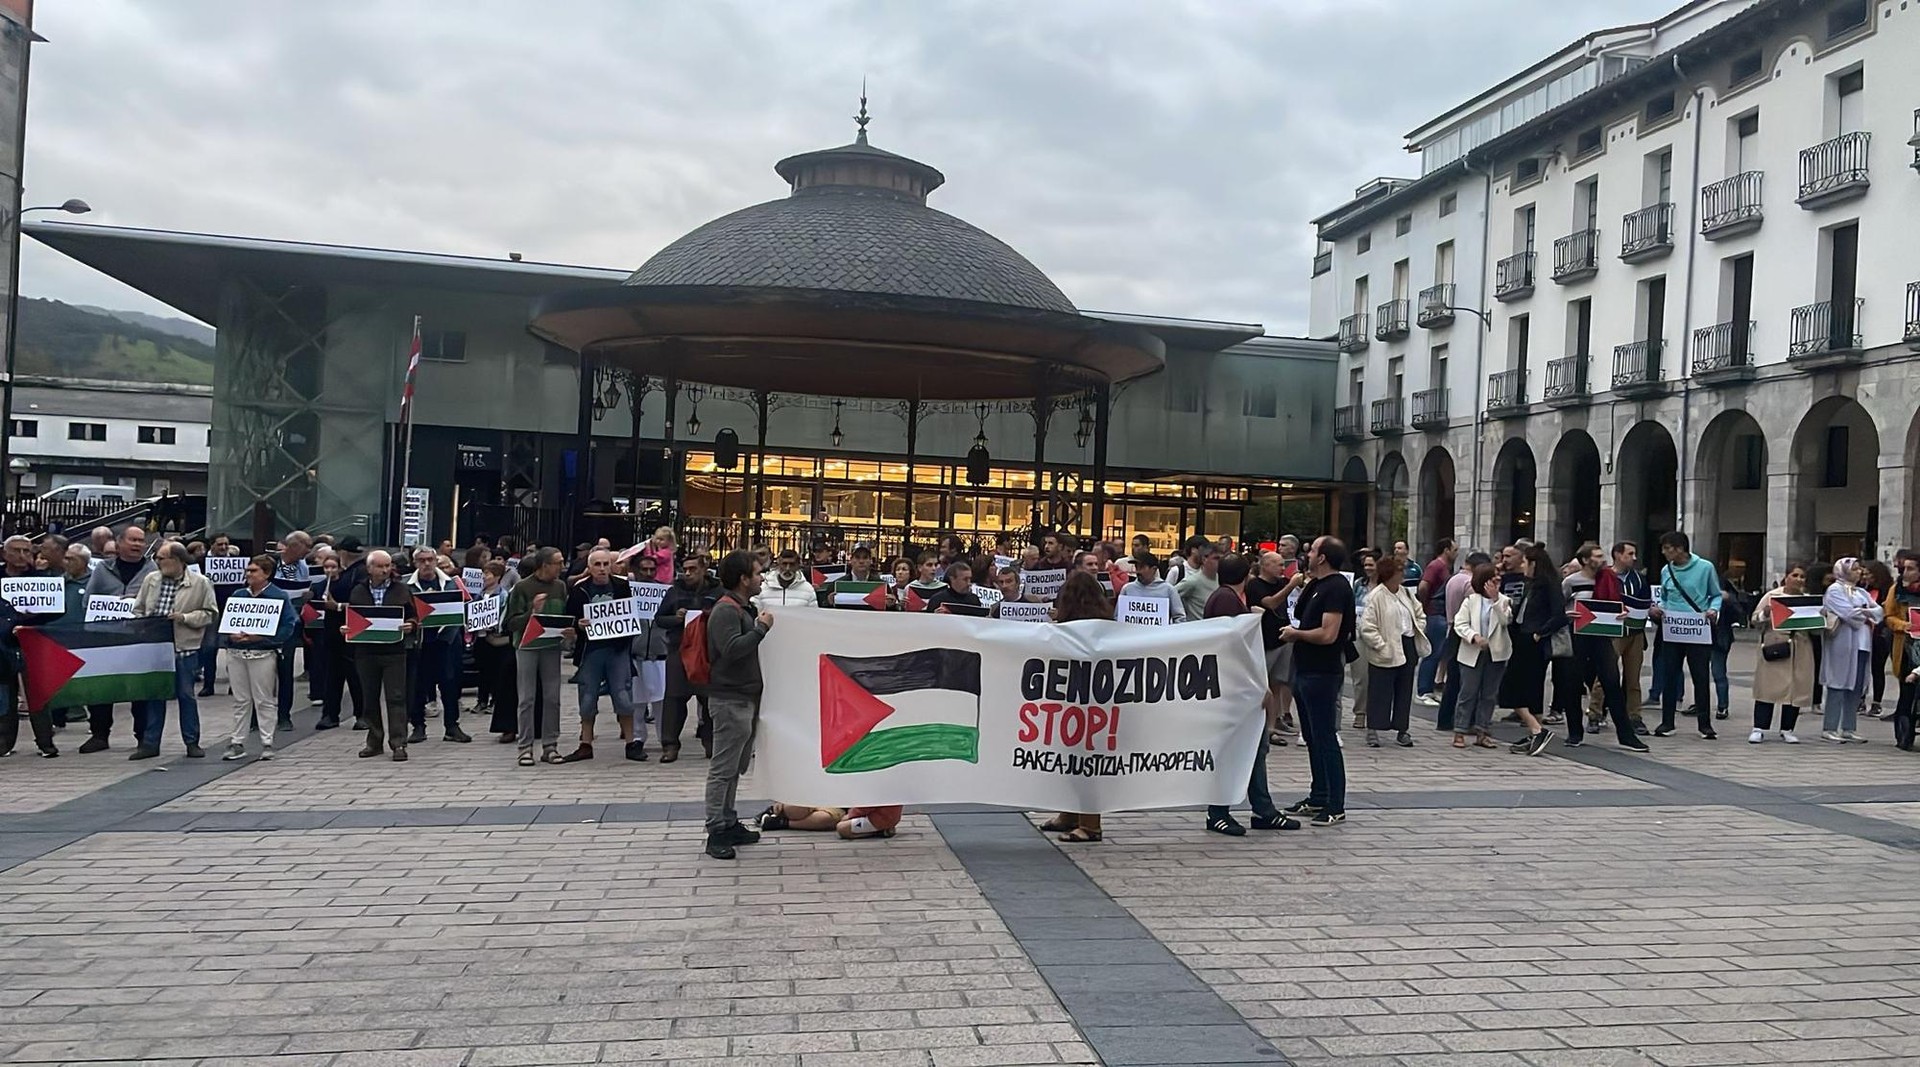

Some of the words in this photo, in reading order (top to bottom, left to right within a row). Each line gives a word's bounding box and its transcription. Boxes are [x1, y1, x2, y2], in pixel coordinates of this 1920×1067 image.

[210, 558, 246, 570] ISRAELI
[1025, 573, 1065, 584] GENOZIDIOA
[3, 583, 63, 593] GENOZIDIOA
[11, 596, 56, 607] GELDITU!
[471, 599, 498, 616] ISRAELI
[1128, 601, 1159, 613] ISRAELI
[226, 602, 280, 615] GENOZIDIOA
[589, 600, 632, 620] ISRAELI
[229, 617, 270, 629] GELDITU!
[586, 617, 640, 637] BOIKOTA
[1020, 654, 1221, 704] GENOZIDIOA
[1018, 702, 1120, 751] STOP!
[1012, 748, 1215, 777] BAKEA-JUSTIZIA-ITXAROPENA
